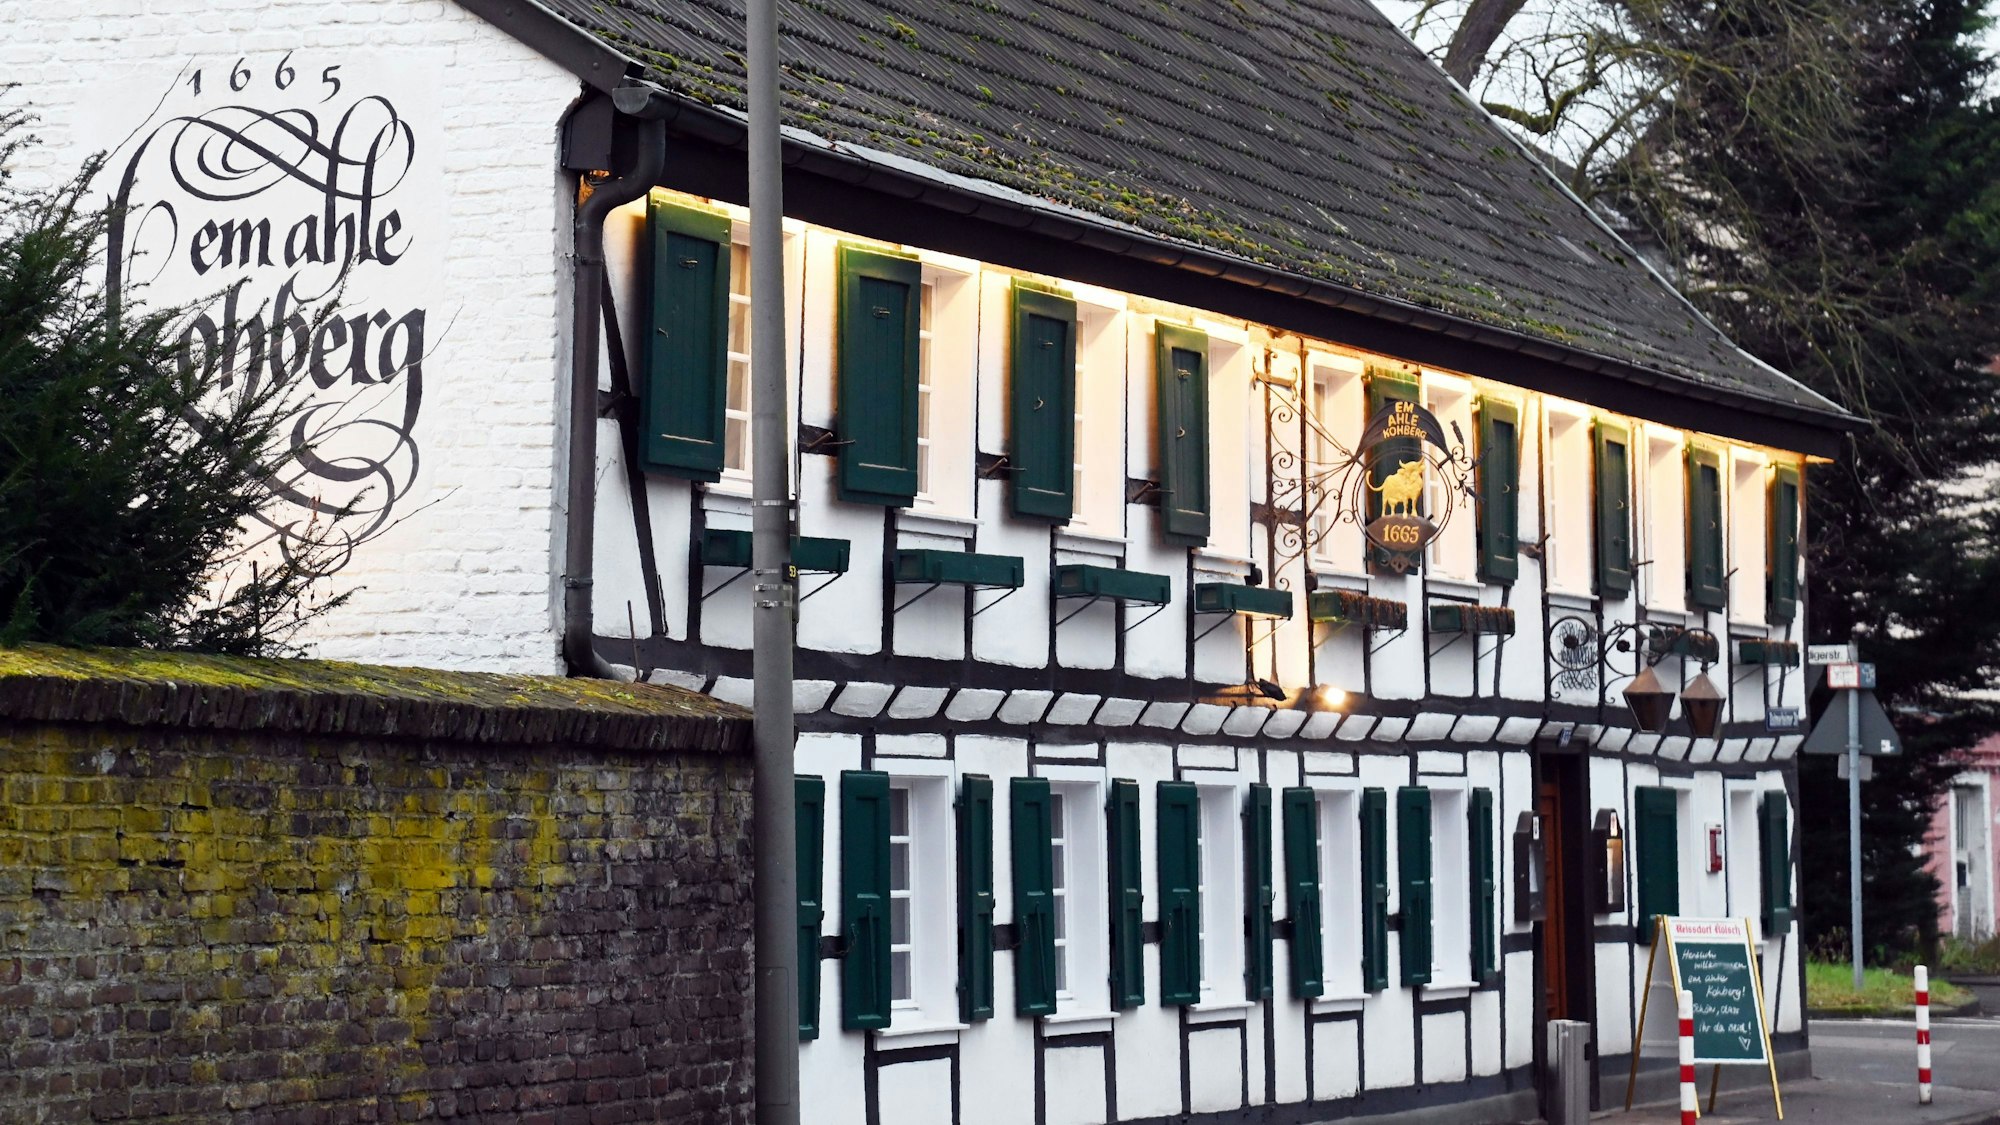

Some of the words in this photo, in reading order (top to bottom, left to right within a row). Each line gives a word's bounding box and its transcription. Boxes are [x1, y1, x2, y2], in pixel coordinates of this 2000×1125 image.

[186, 51, 343, 103] 1665
[190, 217, 275, 276] em
[284, 180, 414, 292] ahle
[1394, 401, 1415, 413] EM
[1388, 413, 1420, 427] AHLE
[1383, 426, 1427, 439] KOHBERG
[1383, 524, 1420, 543] 1665
